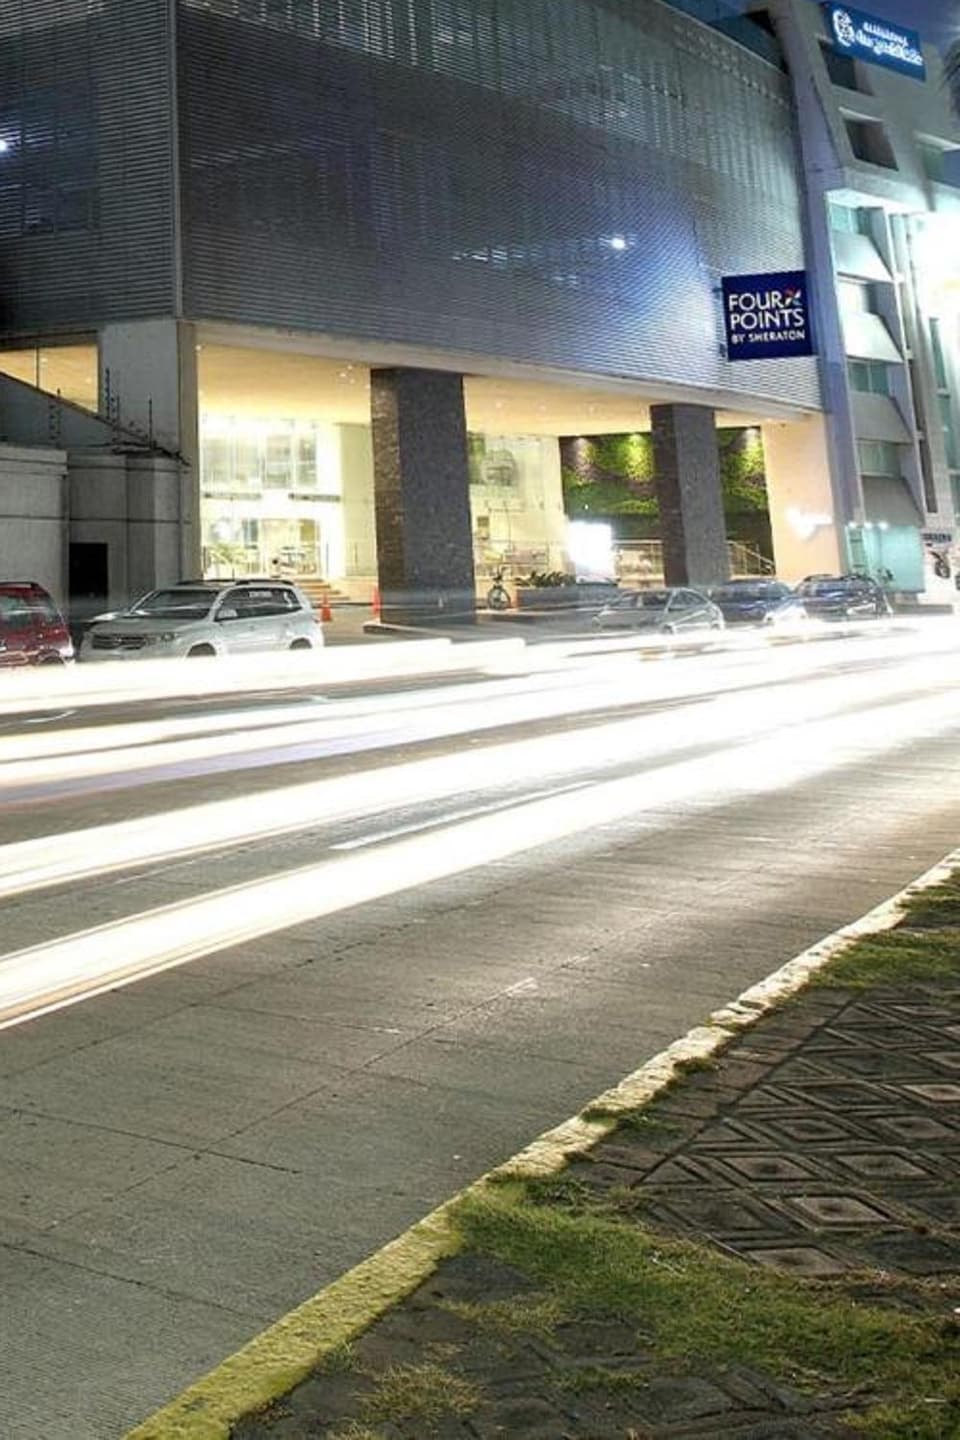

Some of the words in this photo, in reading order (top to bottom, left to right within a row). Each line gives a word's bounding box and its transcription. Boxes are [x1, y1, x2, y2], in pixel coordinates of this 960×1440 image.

[728, 290, 784, 312] FOUR
[730, 308, 805, 331] POINTS
[731, 334, 746, 345] BY
[748, 329, 806, 343] SHERATON
